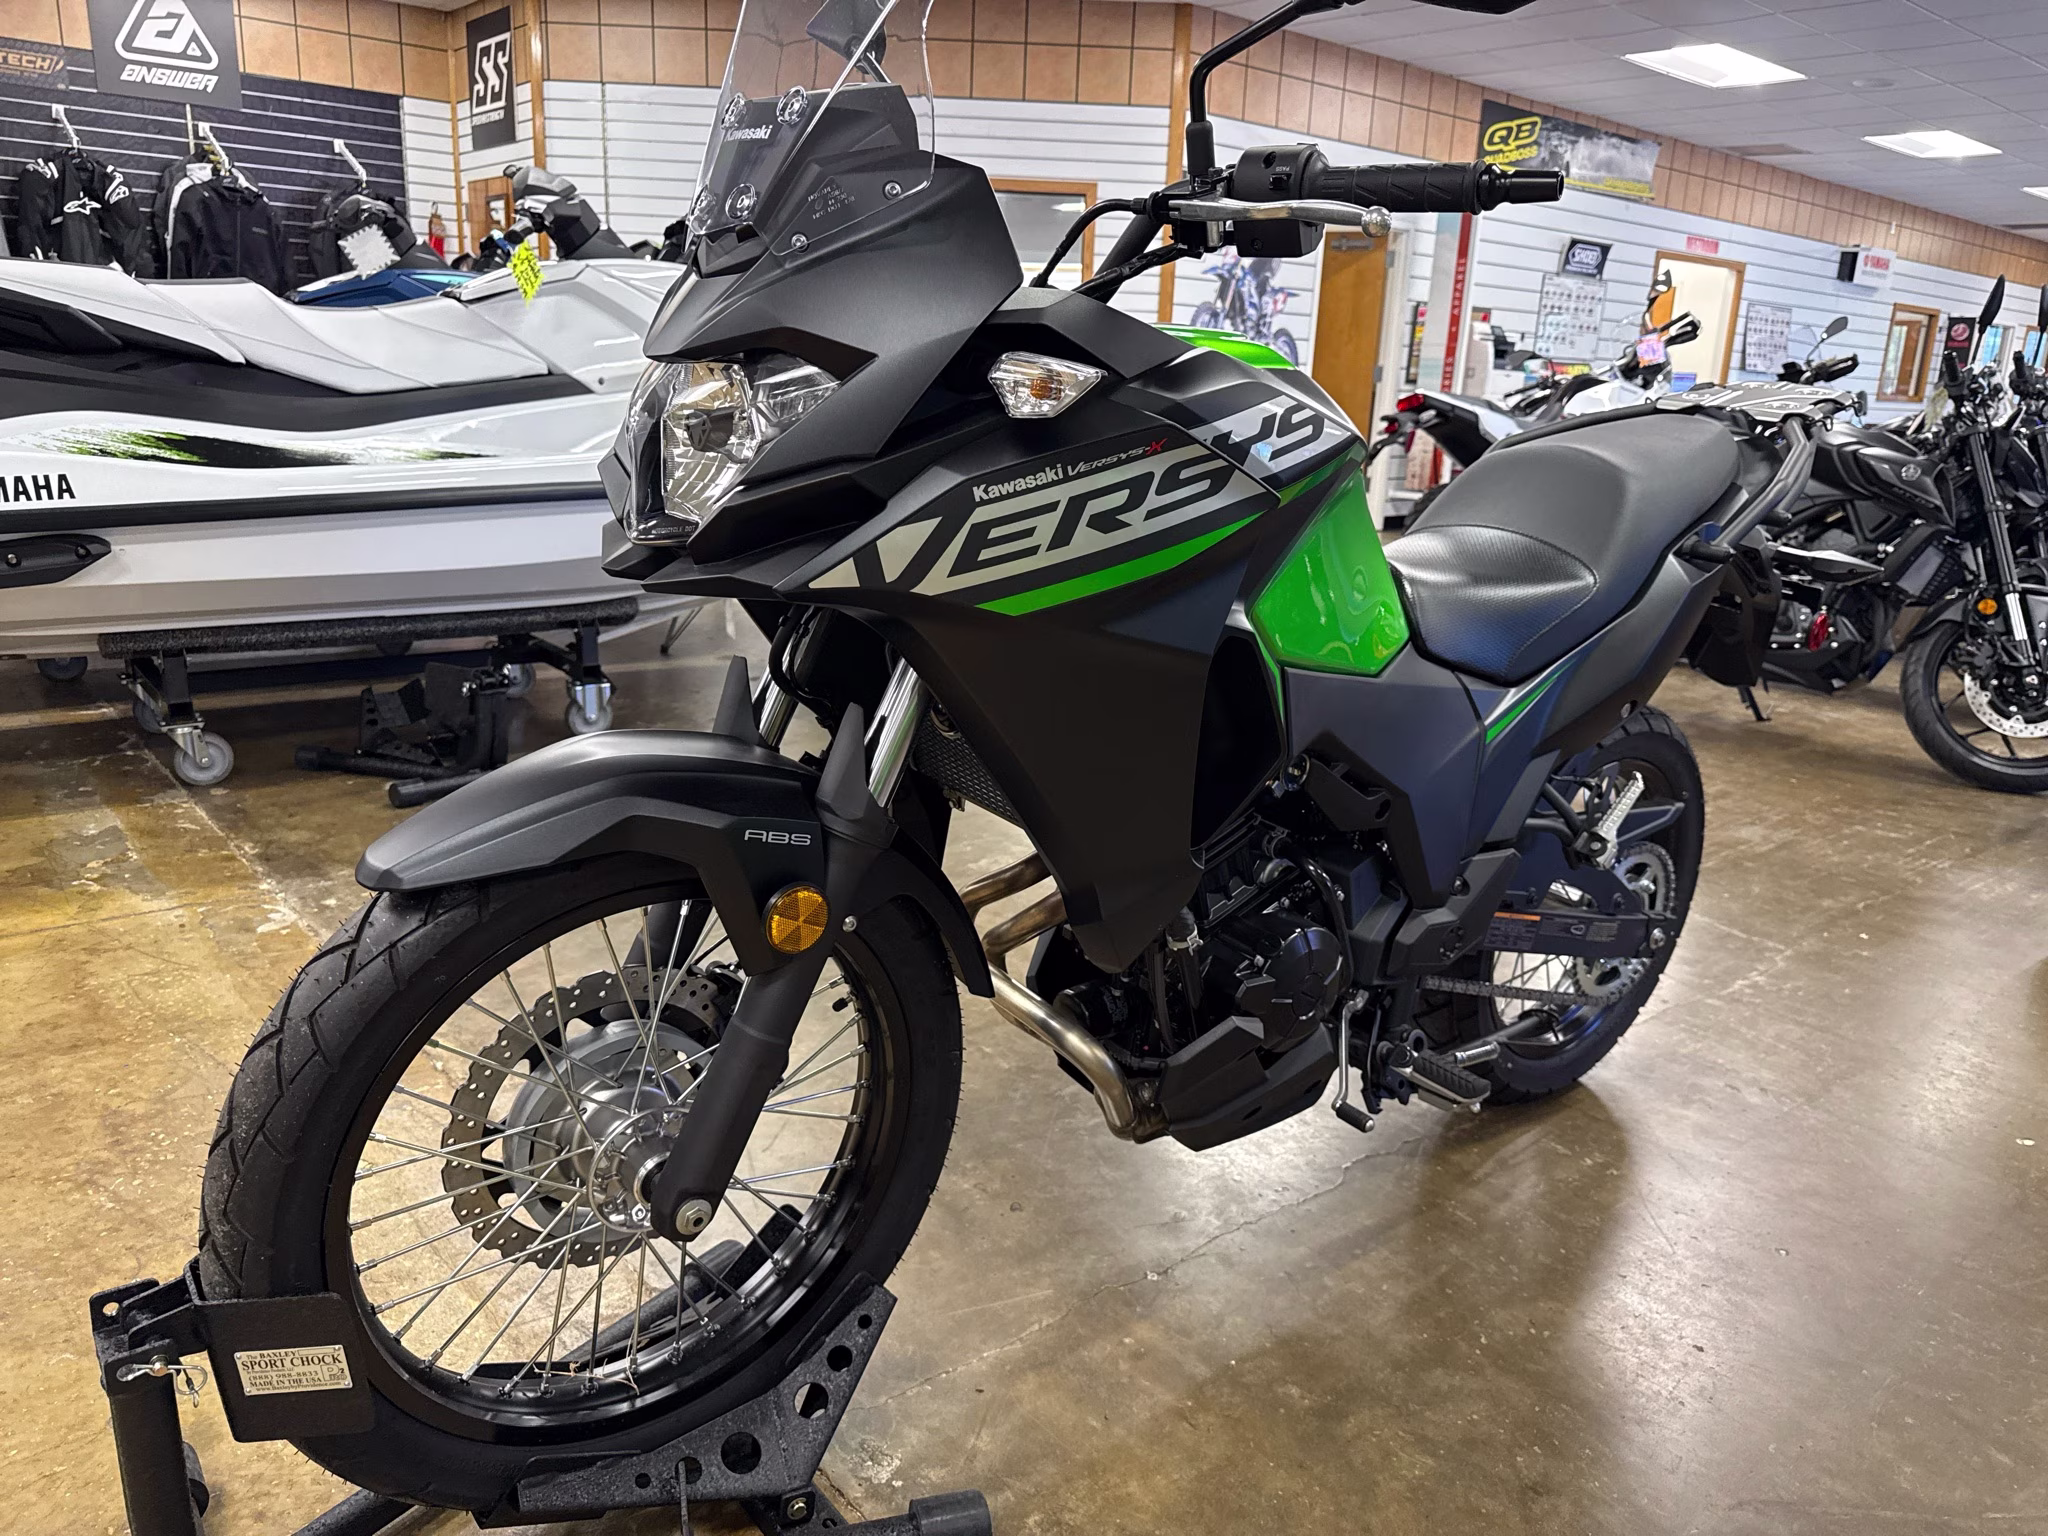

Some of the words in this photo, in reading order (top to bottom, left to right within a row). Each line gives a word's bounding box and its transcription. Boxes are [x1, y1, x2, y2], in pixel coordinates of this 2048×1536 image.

[724, 125, 773, 141] Kawasaki
[1483, 116, 1542, 151] QB
[972, 464, 1064, 502] Kawasaki
[1068, 438, 1169, 477] VERSYS-X
[744, 829, 812, 846] ABS
[241, 1358, 287, 1371] SPORT
[290, 1354, 343, 1367] CHOCK
[260, 1350, 298, 1359] BAXLEY
[250, 1380, 275, 1388] MADE
[276, 1378, 286, 1386] IN
[286, 1377, 305, 1385] THE
[306, 1376, 323, 1384] USA
[275, 1370, 319, 1379] 988-8833
